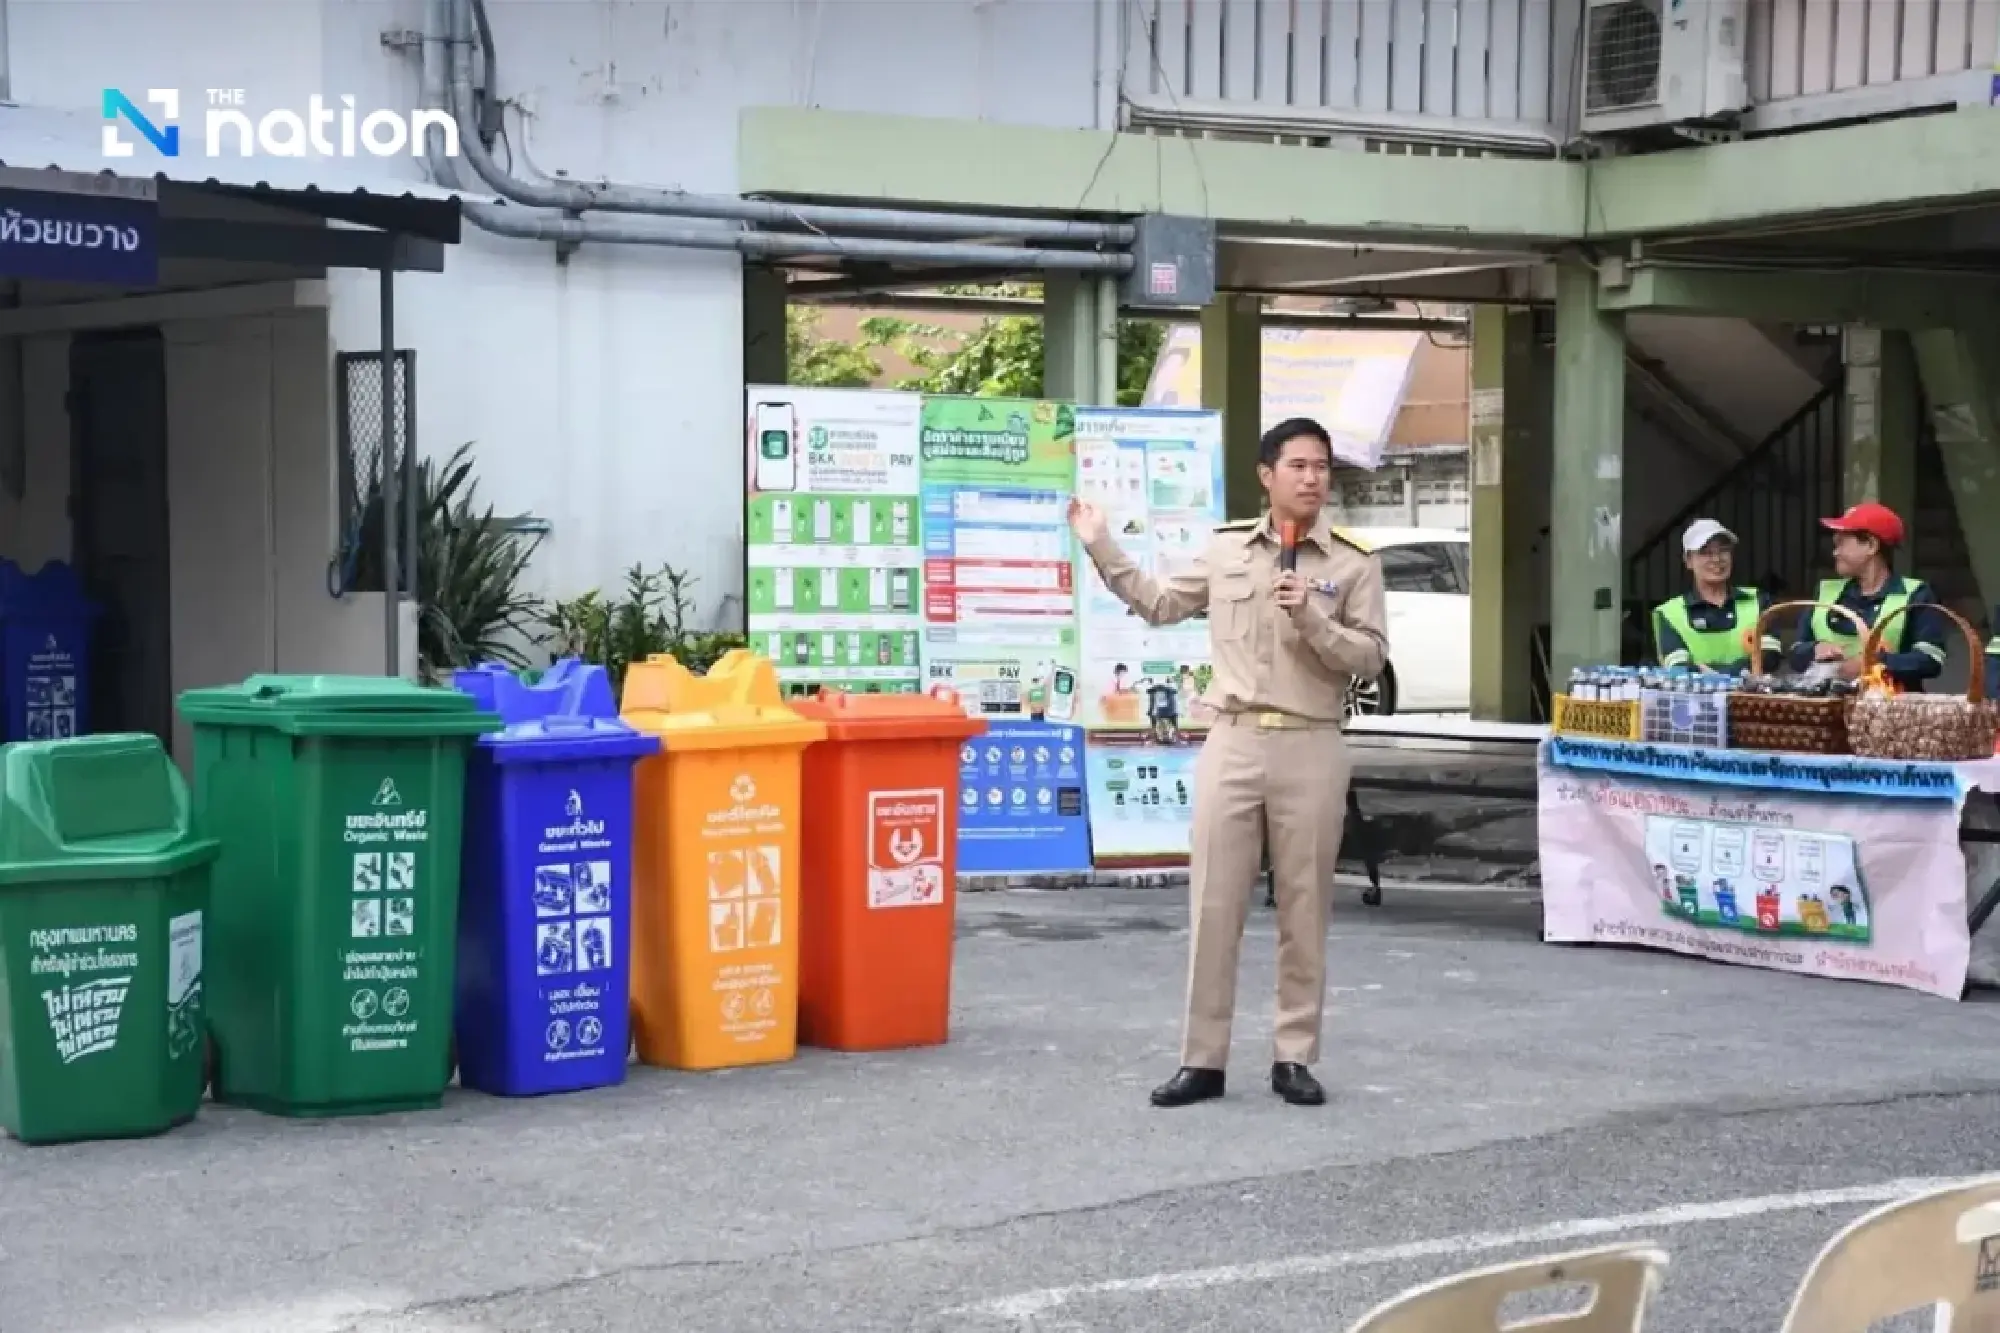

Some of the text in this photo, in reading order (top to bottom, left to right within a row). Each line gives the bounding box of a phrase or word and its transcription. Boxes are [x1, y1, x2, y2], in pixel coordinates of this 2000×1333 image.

[808, 452, 836, 466] BKK
[890, 453, 914, 467] PAY
[929, 665, 1021, 678] BKK PAY
[344, 829, 389, 844] Organic
[30, 923, 138, 953] กรุงเทพมหานคร
